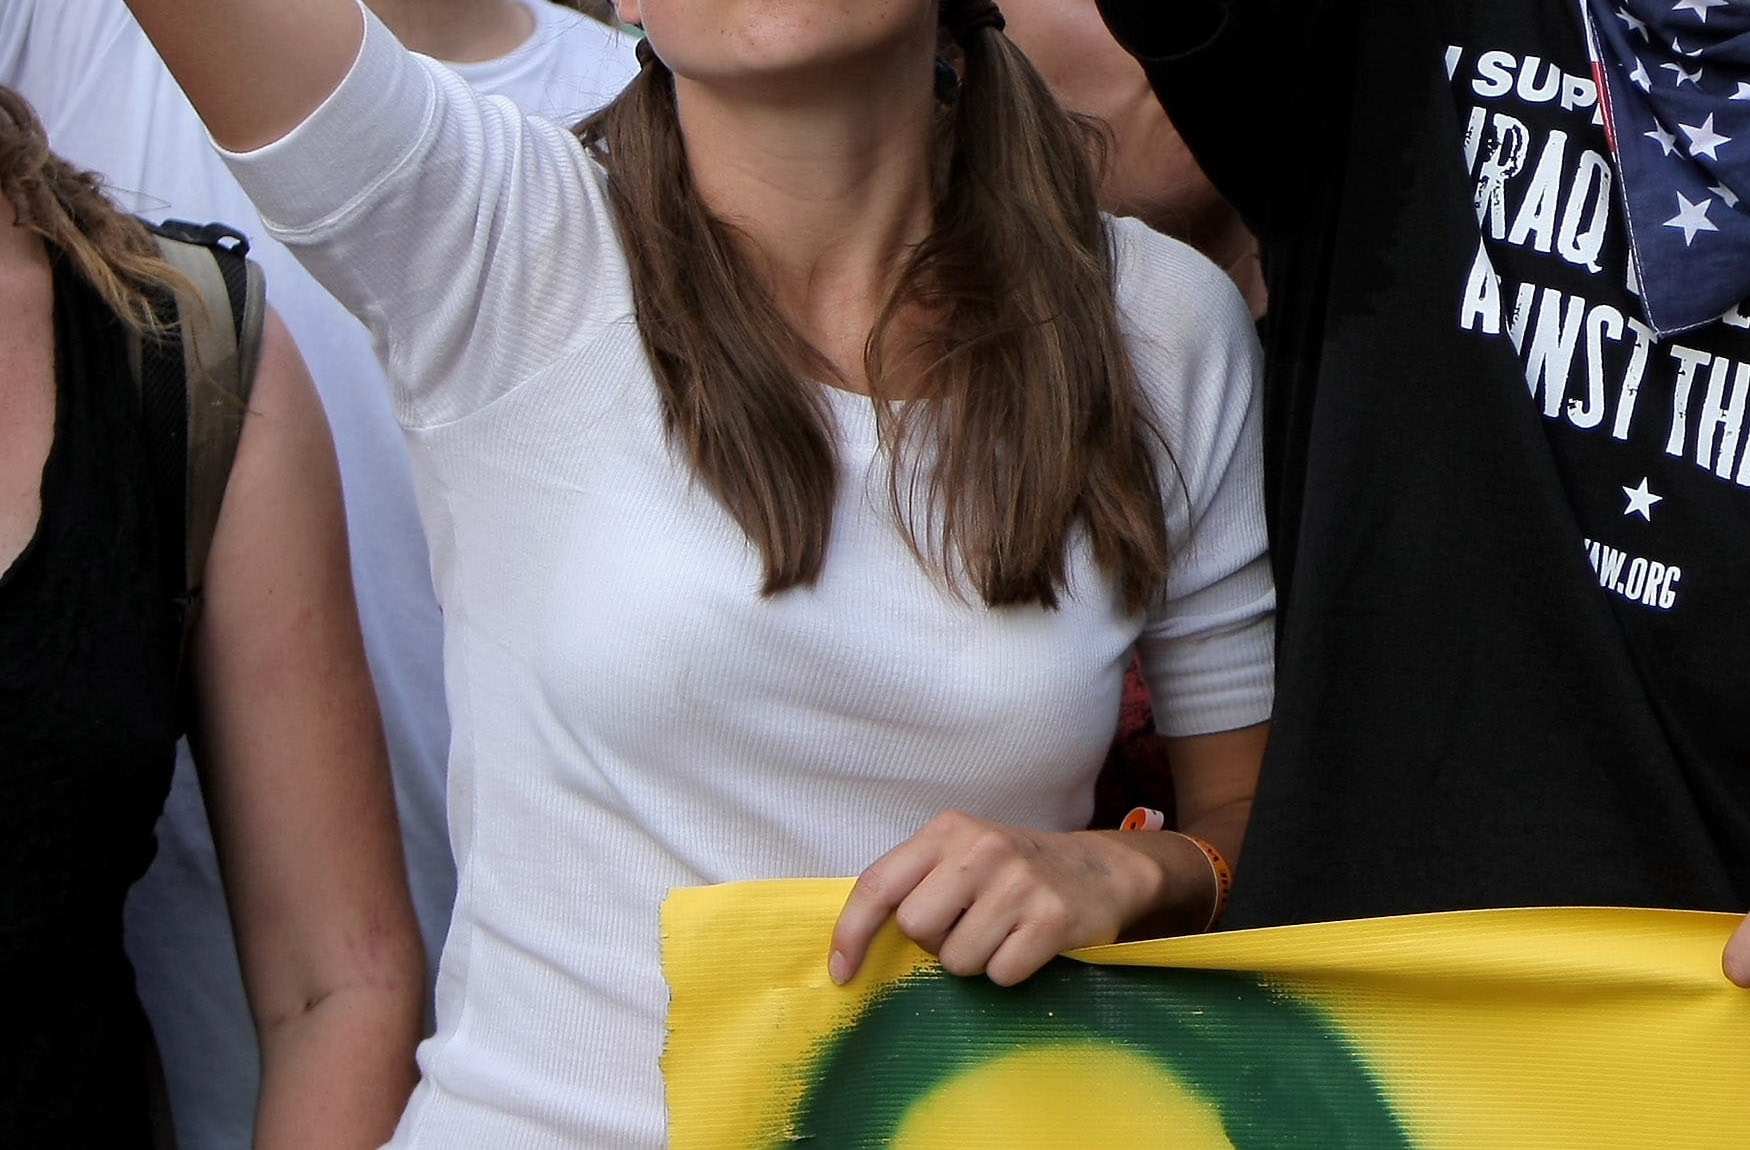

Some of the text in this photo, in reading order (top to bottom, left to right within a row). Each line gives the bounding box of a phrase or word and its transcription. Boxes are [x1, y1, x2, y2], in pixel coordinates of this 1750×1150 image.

[1471, 50, 1605, 126] SUP
[1463, 106, 1612, 274] IRAQ
[1460, 235, 1659, 441] AINST
